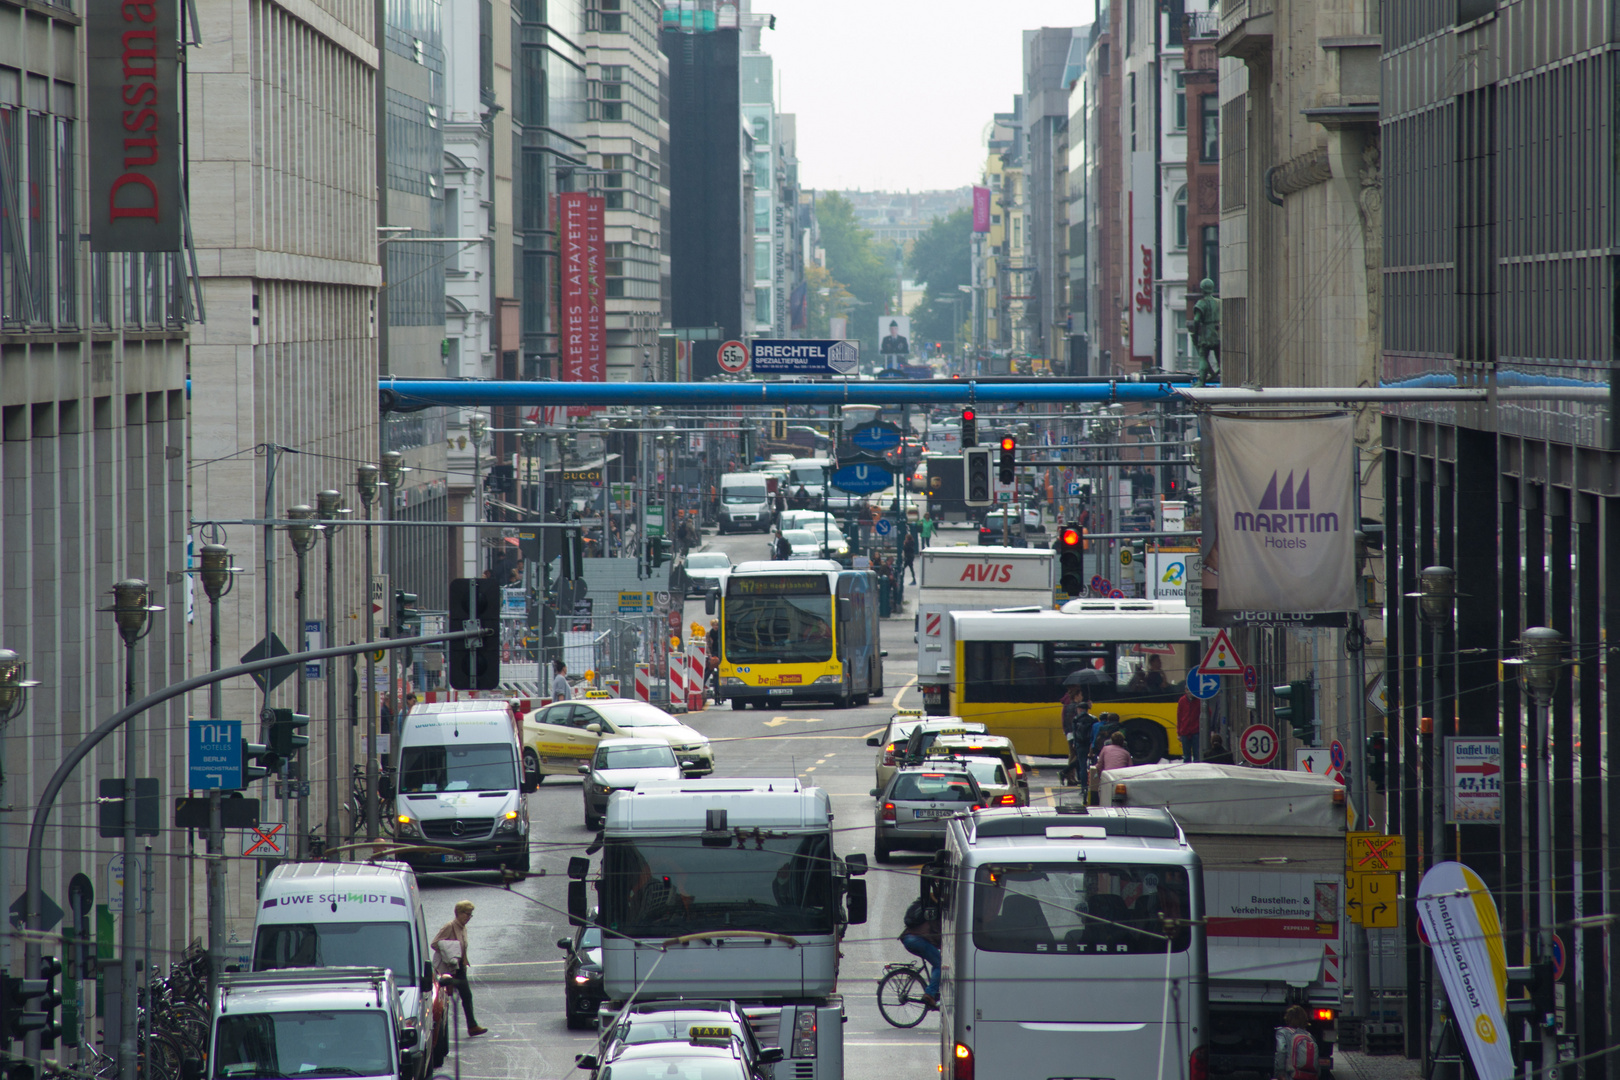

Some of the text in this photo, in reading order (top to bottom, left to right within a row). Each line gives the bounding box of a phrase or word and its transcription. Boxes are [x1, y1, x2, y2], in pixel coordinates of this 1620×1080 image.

[776, 206, 785, 339] ERMUSEUM THE WALL LE MUR
[1136, 244, 1152, 313] Leiser
[568, 200, 583, 382] ALERIES LAFAYETTE
[755, 345, 826, 357] BRECHTEL
[755, 357, 809, 365] SPEZIALTIEFBAU
[932, 433, 957, 442] FedEx
[563, 472, 600, 480] GUCCI
[856, 465, 868, 480] U
[1233, 512, 1339, 533] MARITIM
[1264, 536, 1307, 549] Hotels
[960, 563, 1013, 583] AVIS
[758, 675, 769, 684] be
[1248, 736, 1271, 754] 30
[1370, 882, 1378, 893] U
[280, 894, 314, 905] UWE
[319, 892, 387, 905] SCHMIDT
[1251, 895, 1310, 905] Baustellen- &
[1231, 906, 1310, 917] Verkehrssicherung
[1036, 944, 1128, 952] SETRA
[696, 1027, 725, 1035] TAXI
